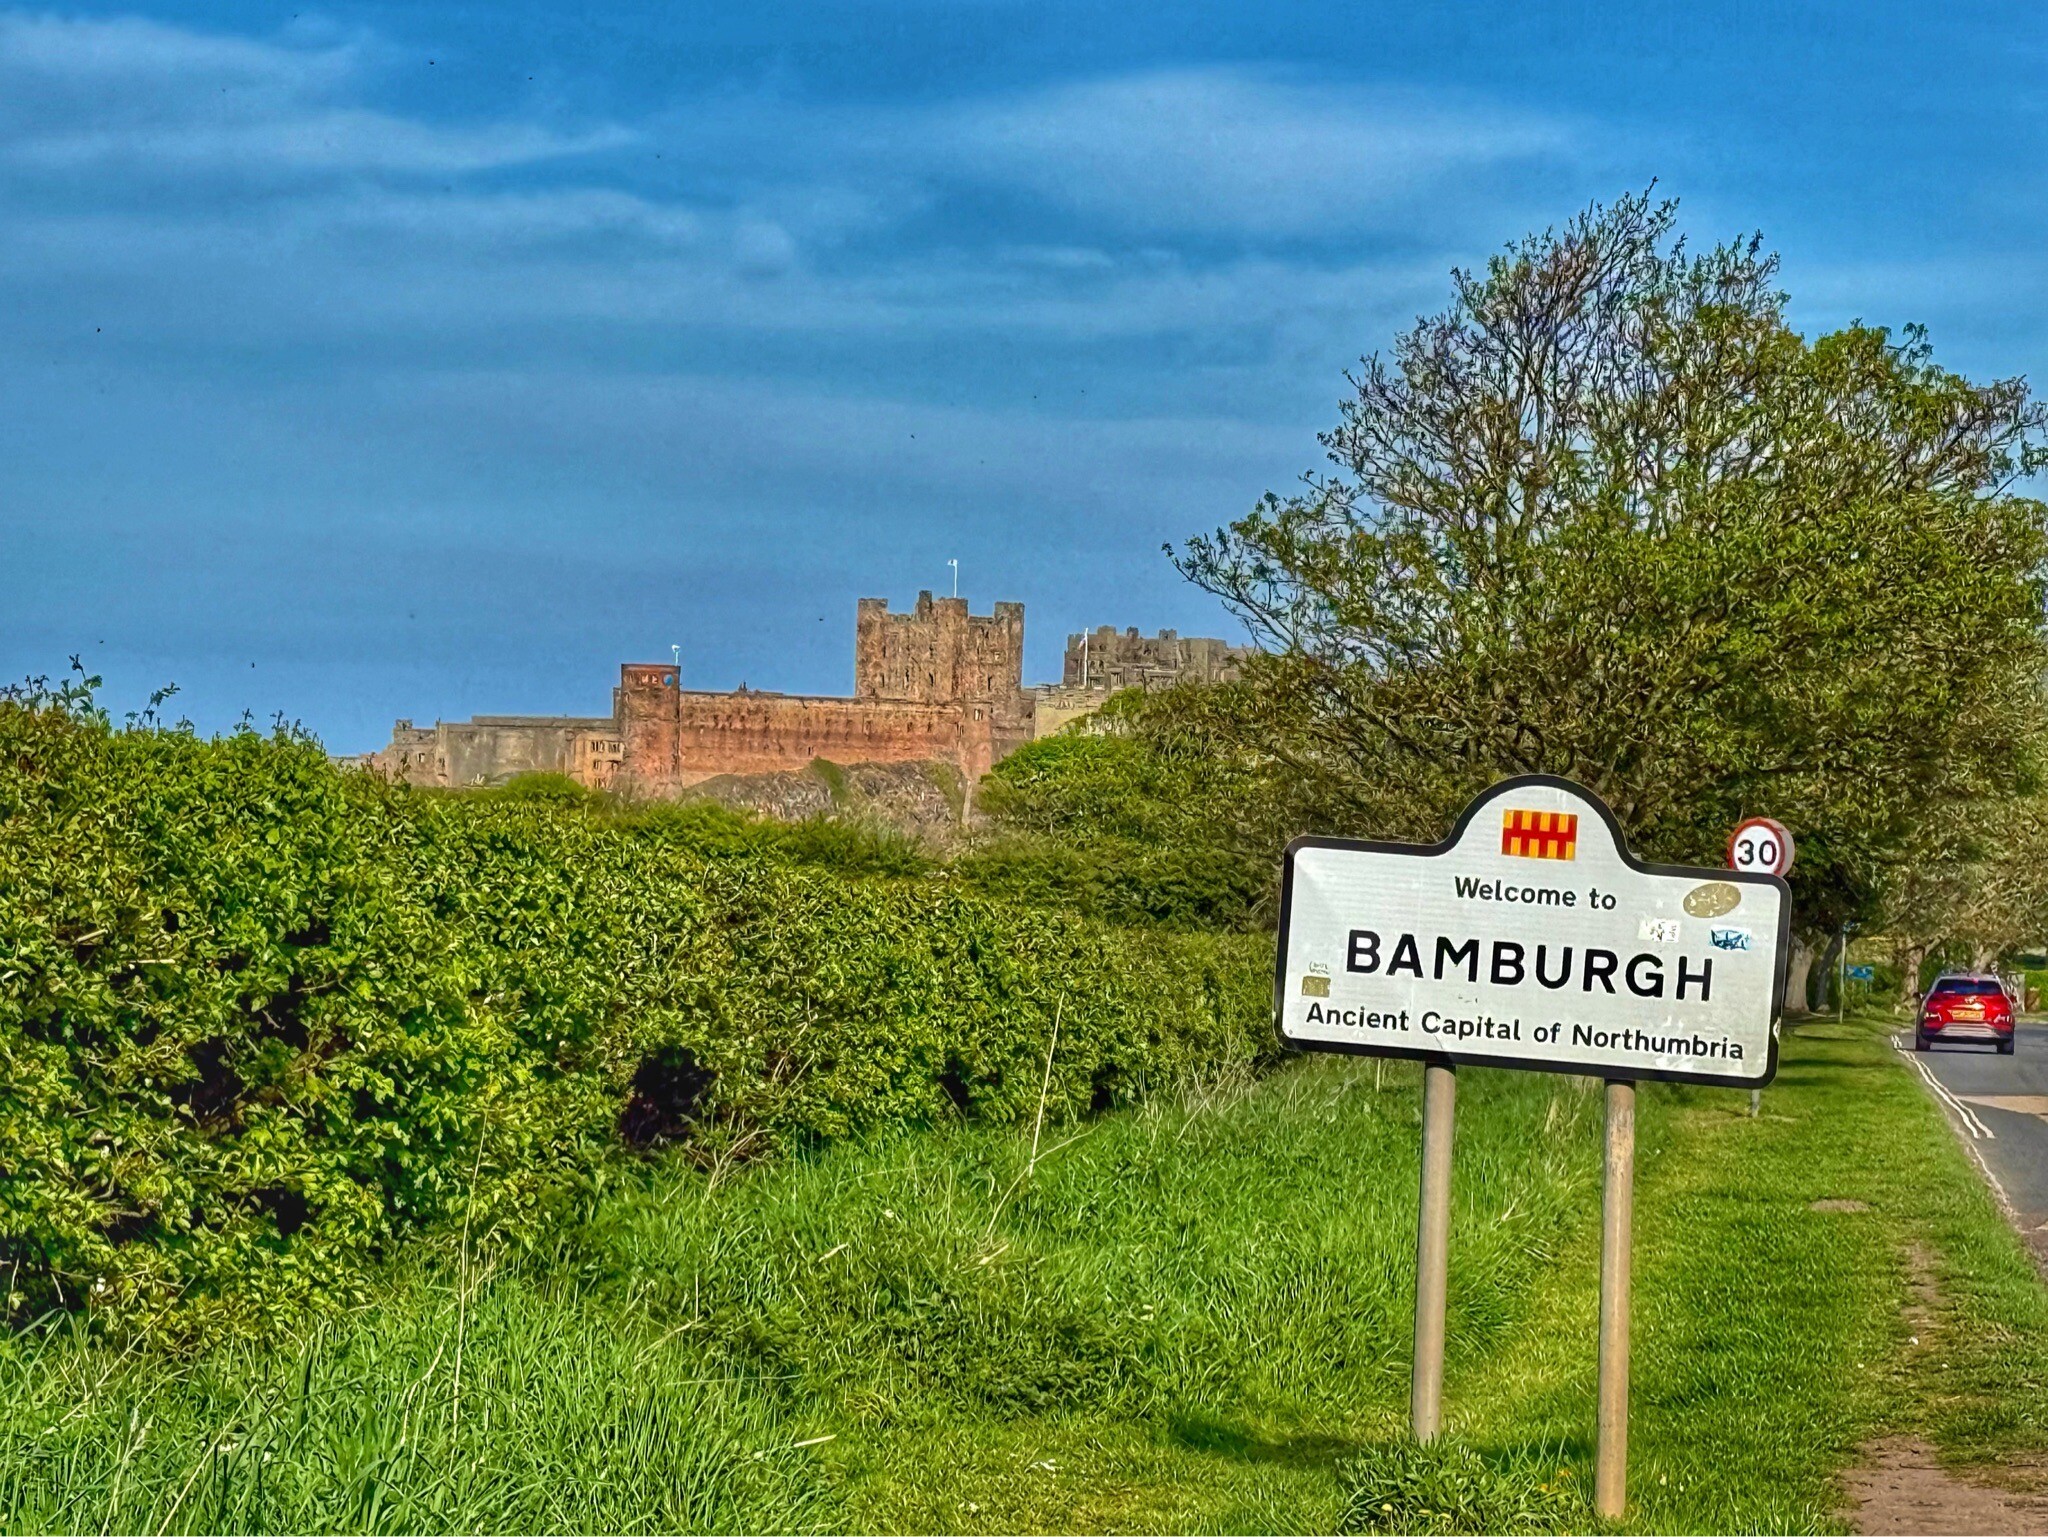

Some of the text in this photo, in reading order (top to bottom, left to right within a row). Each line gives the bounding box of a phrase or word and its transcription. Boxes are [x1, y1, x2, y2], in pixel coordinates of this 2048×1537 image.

[1737, 839, 1777, 866] 30
[1454, 875, 1617, 911] Welcome to
[1346, 929, 1713, 1002] BAMBURGH
[1306, 1002, 1744, 1060] Ancient Capital of Northumbria
